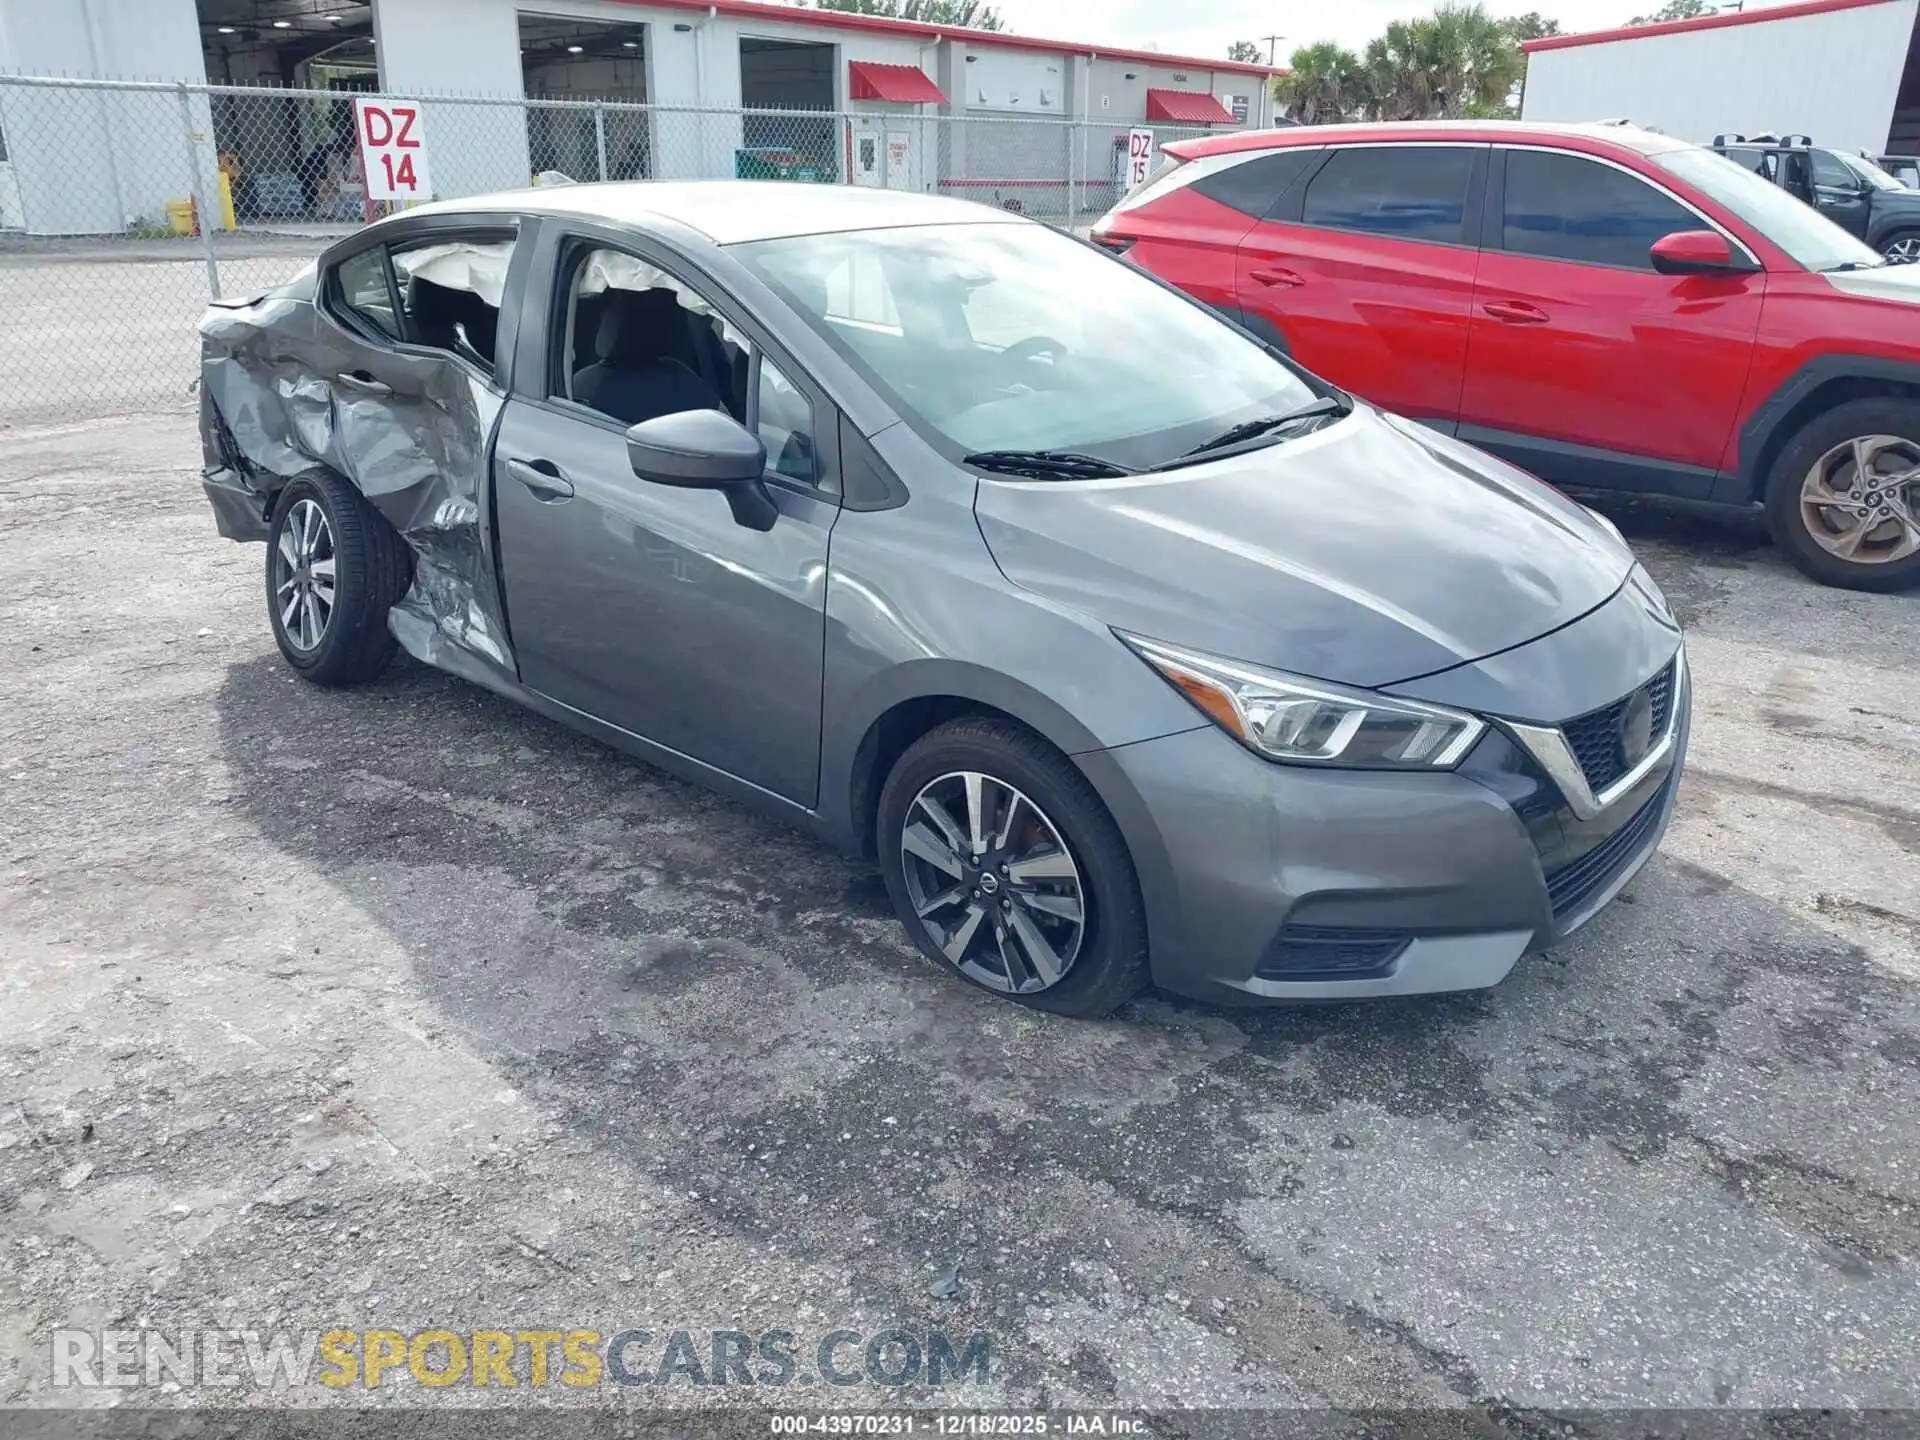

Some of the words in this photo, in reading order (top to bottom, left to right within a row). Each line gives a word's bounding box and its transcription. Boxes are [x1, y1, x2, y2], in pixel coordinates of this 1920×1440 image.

[363, 106, 420, 148] DZ
[1131, 134, 1151, 158] DZ
[380, 153, 417, 192] 14
[1133, 161, 1145, 184] 15
